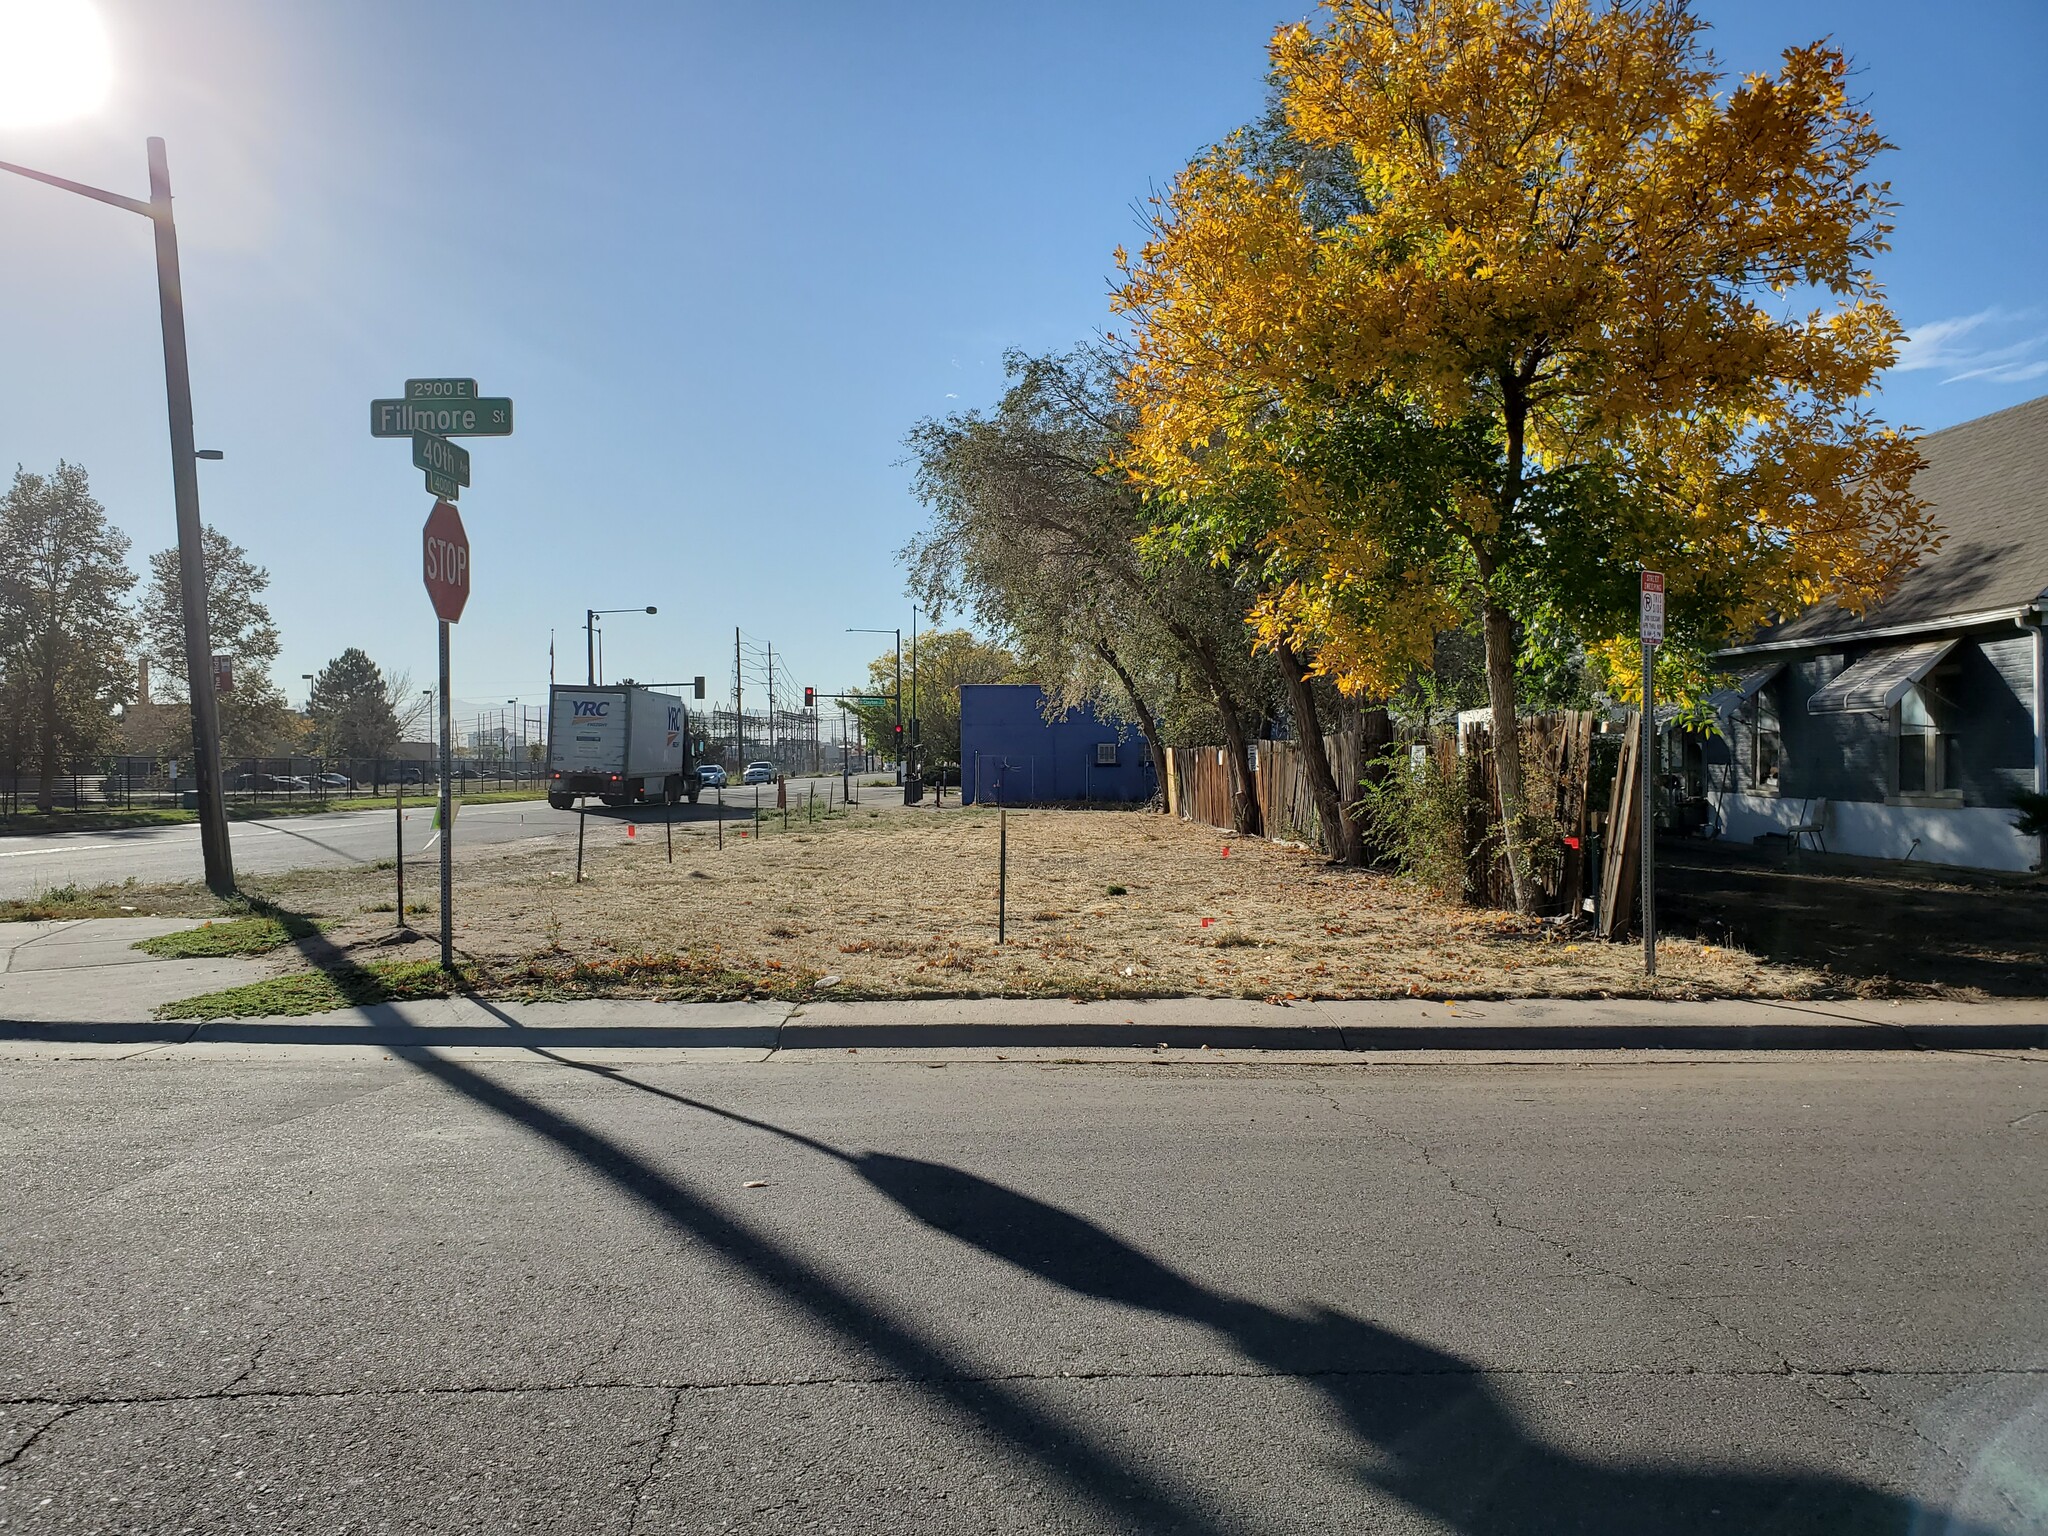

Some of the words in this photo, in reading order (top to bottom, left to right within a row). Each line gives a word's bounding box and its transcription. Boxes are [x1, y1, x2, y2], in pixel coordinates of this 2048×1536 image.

[414, 382, 452, 396] 2900
[457, 382, 466, 395] E
[381, 405, 476, 431] Fillmore
[492, 409, 505, 423] St
[423, 439, 455, 474] 40th
[427, 536, 467, 586] STOP
[1653, 594, 1661, 603] THIS
[1653, 604, 1662, 613] SIDE
[573, 700, 610, 716] YRC
[668, 706, 681, 731] YRC
